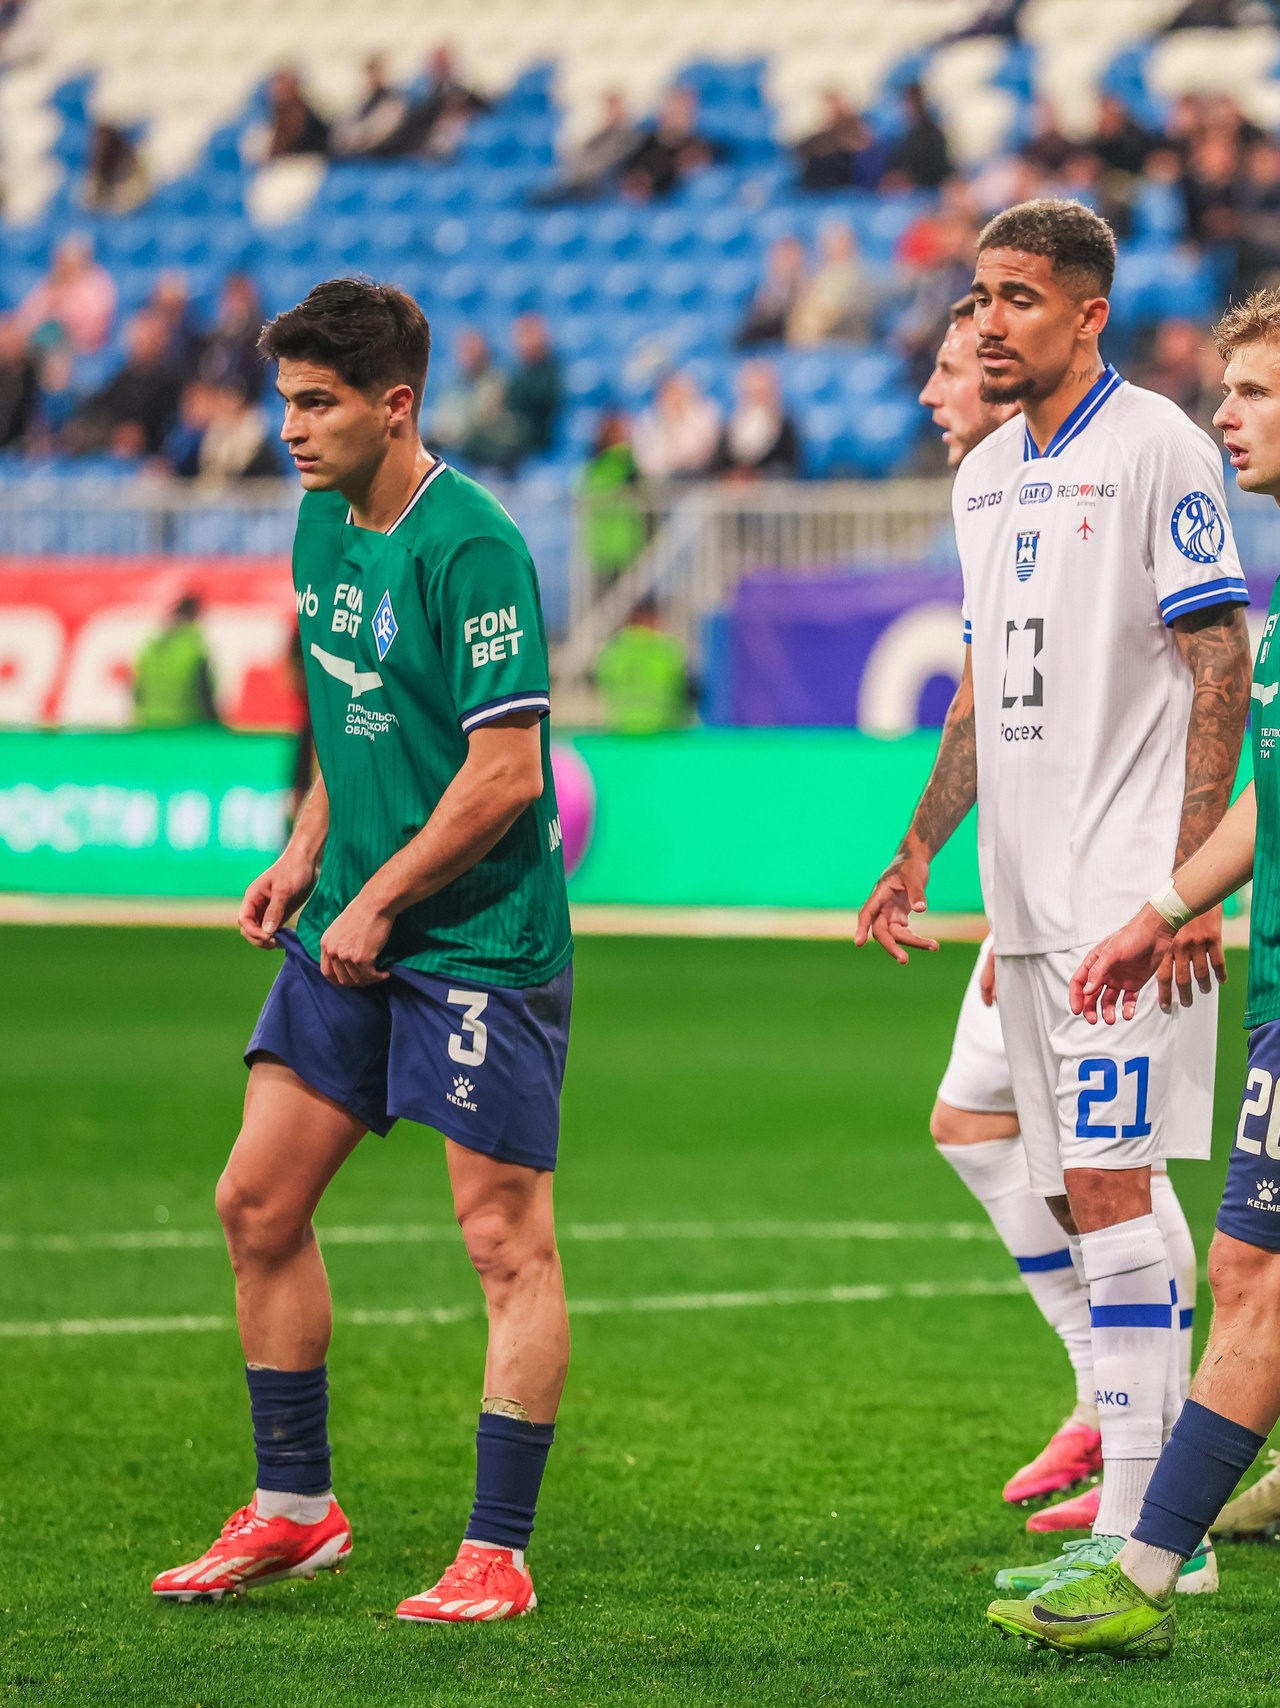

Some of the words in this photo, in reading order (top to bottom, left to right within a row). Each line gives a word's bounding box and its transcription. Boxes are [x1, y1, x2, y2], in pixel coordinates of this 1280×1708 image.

[464, 605, 517, 644] FON
[471, 629, 524, 669] BET
[447, 988, 489, 1067] 3
[446, 1092, 478, 1112] KELME
[1076, 1056, 1152, 1138] 21
[1094, 1389, 1131, 1407] AKO
